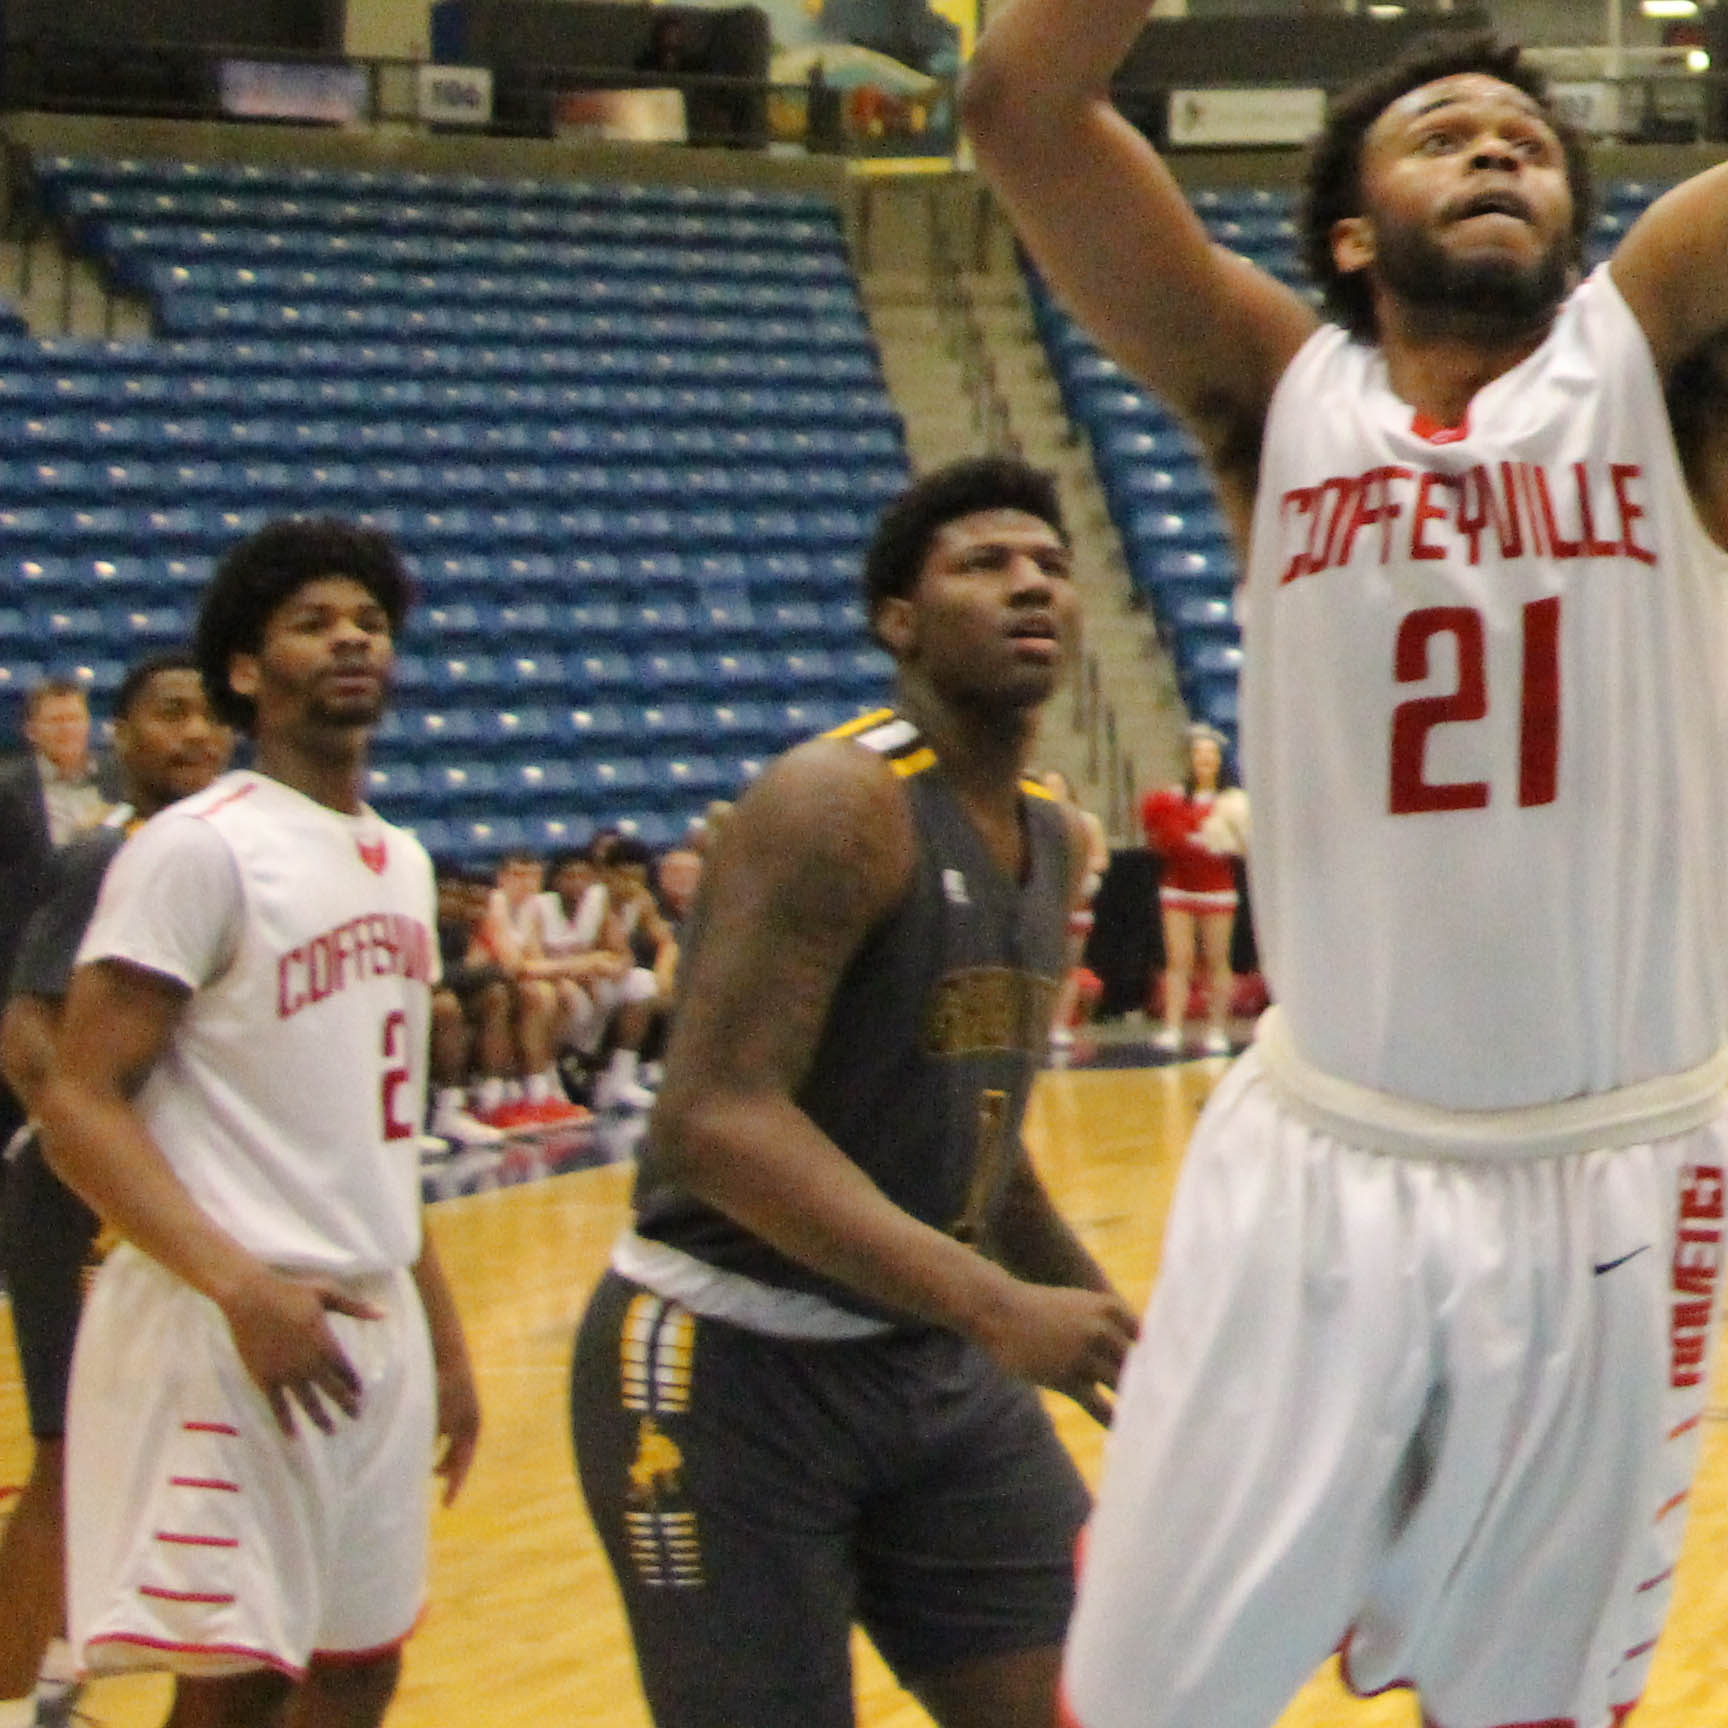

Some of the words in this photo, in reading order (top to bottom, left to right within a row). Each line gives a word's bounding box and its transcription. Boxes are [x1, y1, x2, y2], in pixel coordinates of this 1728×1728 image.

[1279, 459, 1658, 586] COFFEYVILLE
[1388, 595, 1563, 816] 21
[381, 1008, 413, 1142] 2
